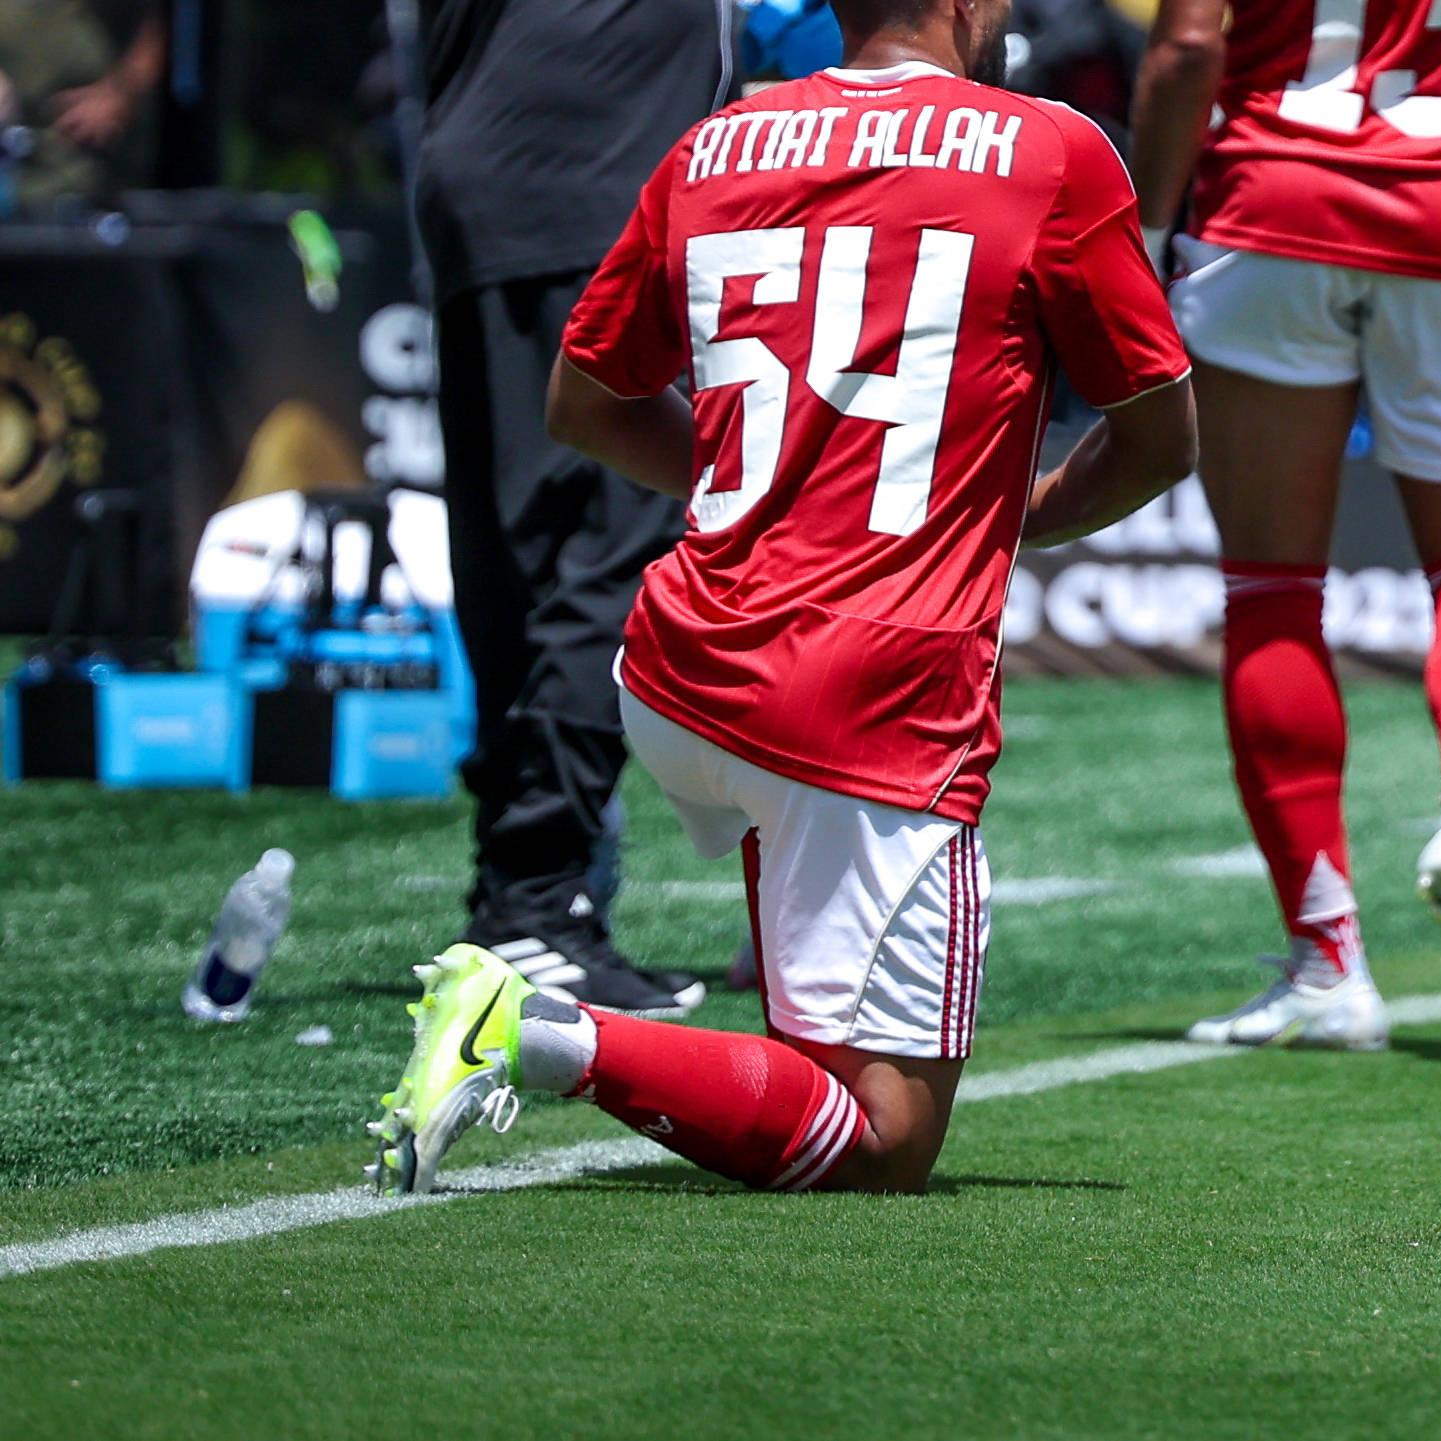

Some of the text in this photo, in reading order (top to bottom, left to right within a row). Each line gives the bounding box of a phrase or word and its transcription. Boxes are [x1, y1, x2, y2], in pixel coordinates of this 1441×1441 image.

[686, 105, 1023, 183] ATTIAT ALLAH
[686, 226, 975, 537] 54
